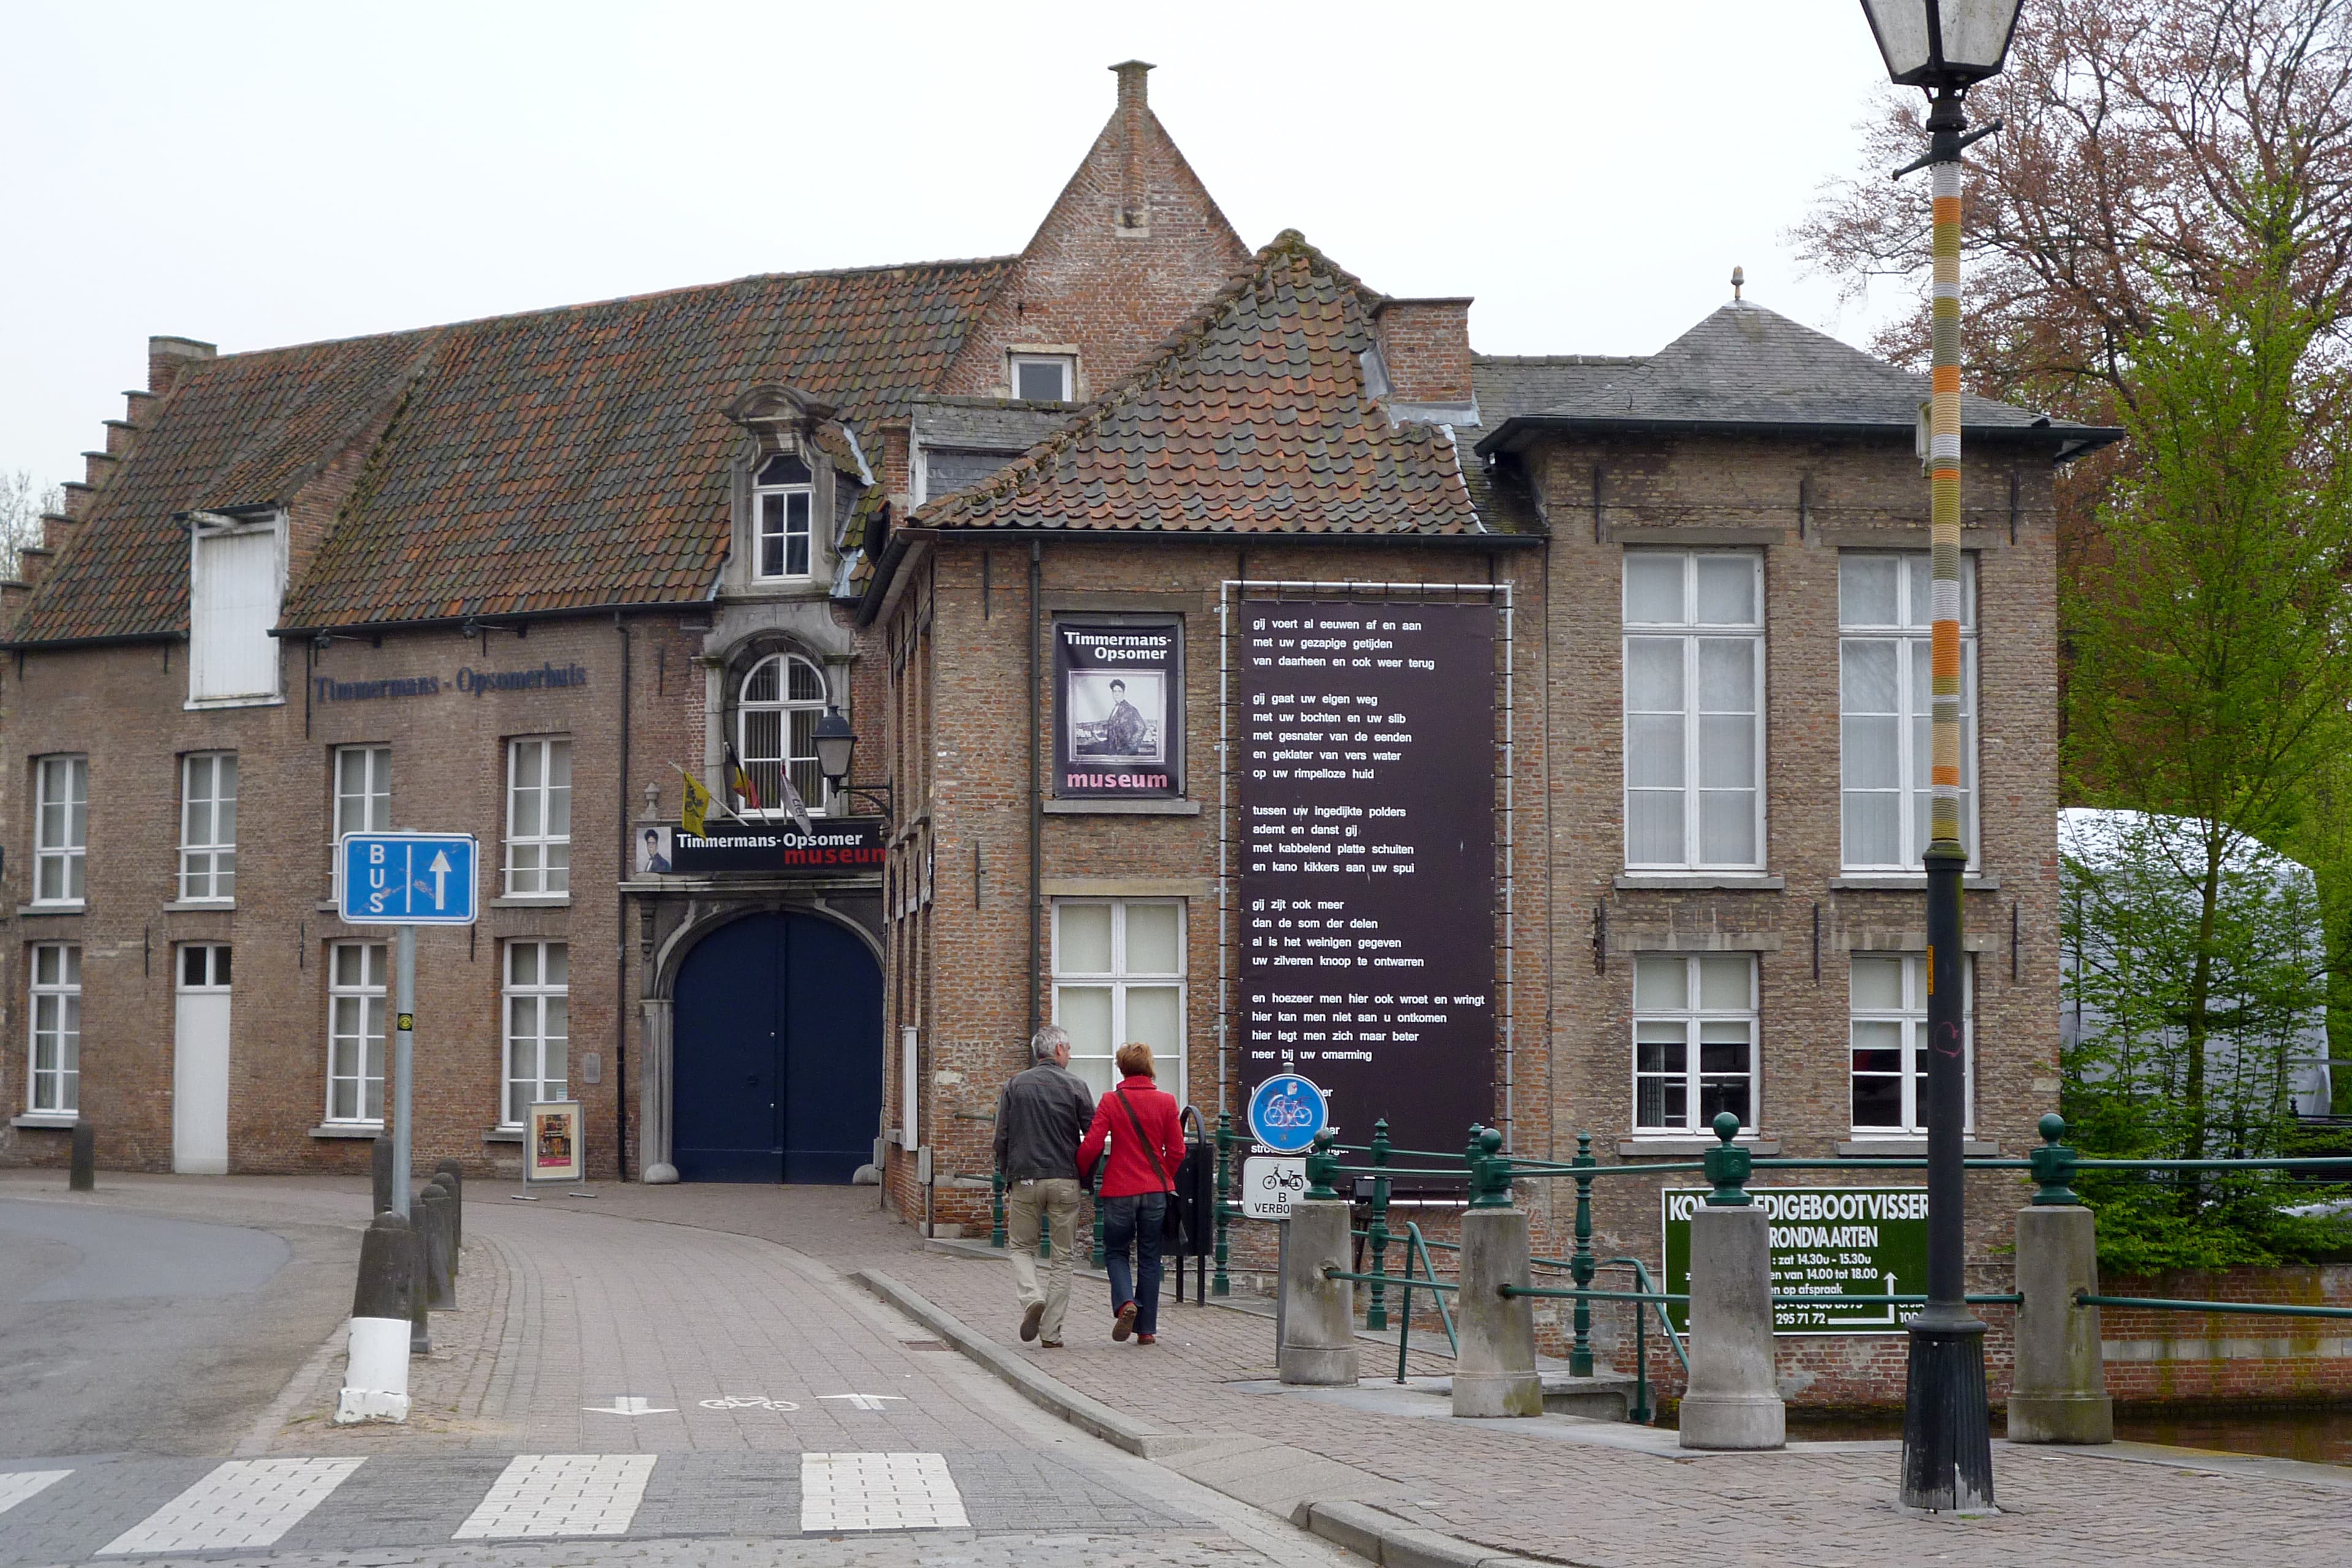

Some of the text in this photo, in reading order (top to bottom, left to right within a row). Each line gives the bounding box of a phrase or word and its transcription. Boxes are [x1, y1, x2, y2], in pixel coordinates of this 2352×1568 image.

[1253, 618, 1422, 631] gij voert al eeuwen af en aan
[1064, 631, 1172, 646] Timmermans-
[1253, 638, 1393, 651] met uw gezapige getijden
[1094, 647, 1167, 662] Opsomer
[1253, 655, 1435, 671] van daarheen en ook weer terug
[314, 676, 439, 703] Timmermans
[456, 661, 586, 696] Opsomerhuis
[1253, 692, 1378, 707] gij gaat uw eigen weg
[1253, 712, 1406, 724] met uw bochten en uw slib
[1253, 731, 1412, 743] met gesnater van de eenden
[1253, 749, 1402, 761] en geklater van vers water
[1253, 769, 1267, 780] op
[1294, 767, 1346, 780] rimpelloze
[1352, 769, 1374, 779] huid
[1067, 773, 1167, 788] museum
[1252, 805, 1406, 818] tussen uw ingedijkte polders
[1253, 823, 1358, 837] ademt en danst gij
[1253, 842, 1414, 856] met kabbelend platte schuiten
[1252, 861, 1414, 875] en kano kikkers aan uw spui
[1252, 899, 1345, 911] gij zijt ook meer
[1252, 917, 1272, 928] dan
[1278, 918, 1292, 928] de
[1326, 918, 1344, 929] der
[1349, 918, 1378, 929] delen
[1252, 936, 1401, 949] al is het weinigen gegeven
[1252, 955, 1424, 968] uw zilveren knoop te ontwarren
[1252, 995, 1265, 1003] en
[1272, 992, 1314, 1003] hoezeer
[1349, 993, 1369, 1004] hier
[1374, 993, 1394, 1004] ook
[1399, 995, 1428, 1005] wroet
[1434, 996, 1447, 1005] en
[1453, 994, 1485, 1007] wringt
[1252, 1011, 1272, 1022] hier
[1278, 1011, 1297, 1022] kan
[1332, 1011, 1352, 1022] niet
[1357, 1014, 1378, 1022] aan
[1397, 1012, 1447, 1023] ontkomen
[1252, 1030, 1420, 1042] hier legt men zich maar beter
[1251, 1049, 1373, 1062] neer bij uw omarming
[1278, 1192, 1287, 1203] B
[1254, 1203, 1289, 1214] VERBO
[1753, 1194, 1928, 1221] EDIGEBOOTVISSER
[1769, 1226, 1879, 1248] RONDVAARTEN
[1778, 1254, 1794, 1265] zat
[1797, 1254, 1830, 1265] 14.30u
[1839, 1253, 1872, 1264] 15.30u
[1784, 1271, 1803, 1280] van
[1807, 1268, 1833, 1280] 14.00
[1835, 1269, 1848, 1280] tot
[1851, 1268, 1878, 1279] 18.00
[1783, 1286, 1796, 1295] op
[1798, 1284, 1843, 1295] afspraak
[1812, 1313, 1826, 1324] 72
